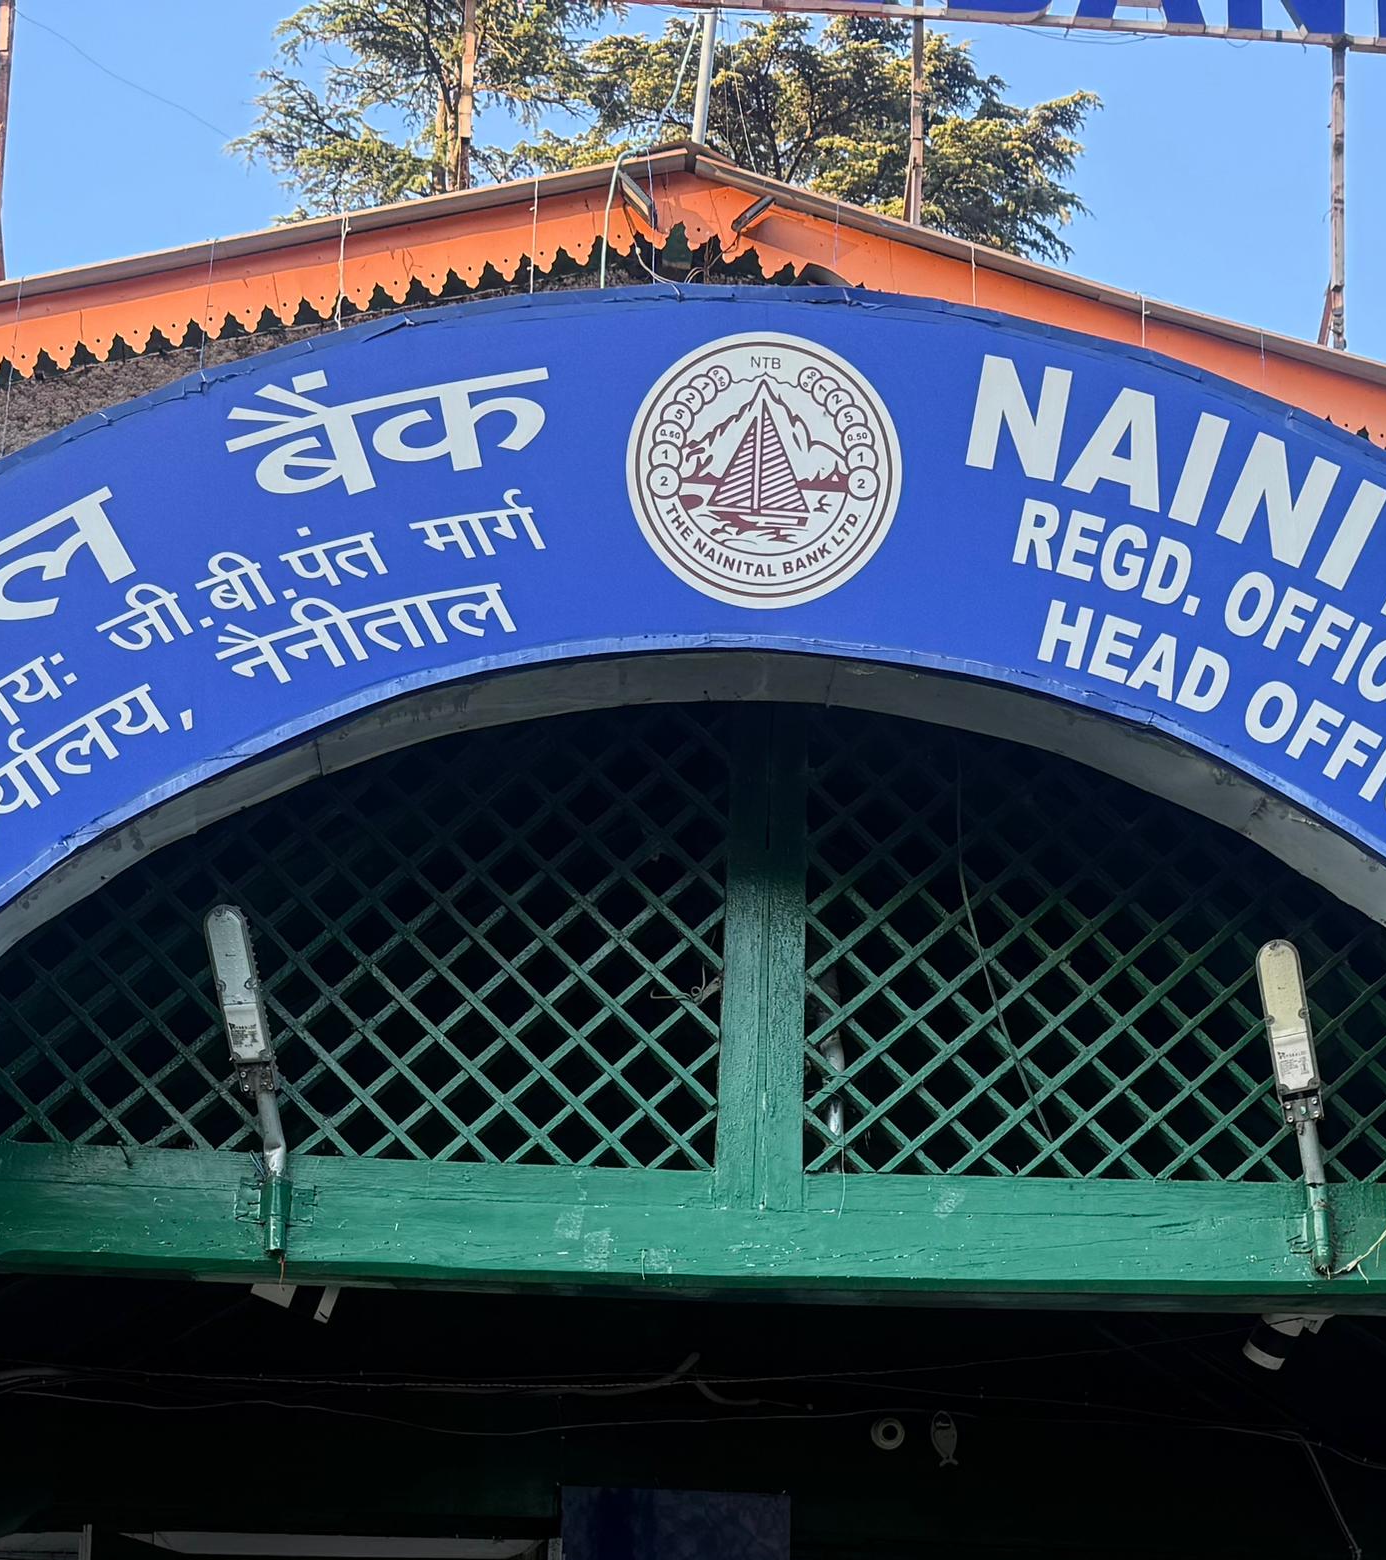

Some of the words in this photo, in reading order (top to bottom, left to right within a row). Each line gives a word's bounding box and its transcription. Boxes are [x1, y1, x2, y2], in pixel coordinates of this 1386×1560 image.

[750, 356, 781, 369] NTB
[225, 366, 550, 496] बैंक
[409, 488, 546, 559] मार्ग
[666, 503, 691, 540] THE
[694, 538, 777, 577] NAINITAL
[782, 543, 832, 576] BANK
[1013, 499, 1201, 617] REGD.
[215, 582, 517, 684] नैनीताल
[1038, 599, 1230, 713] HEAD
